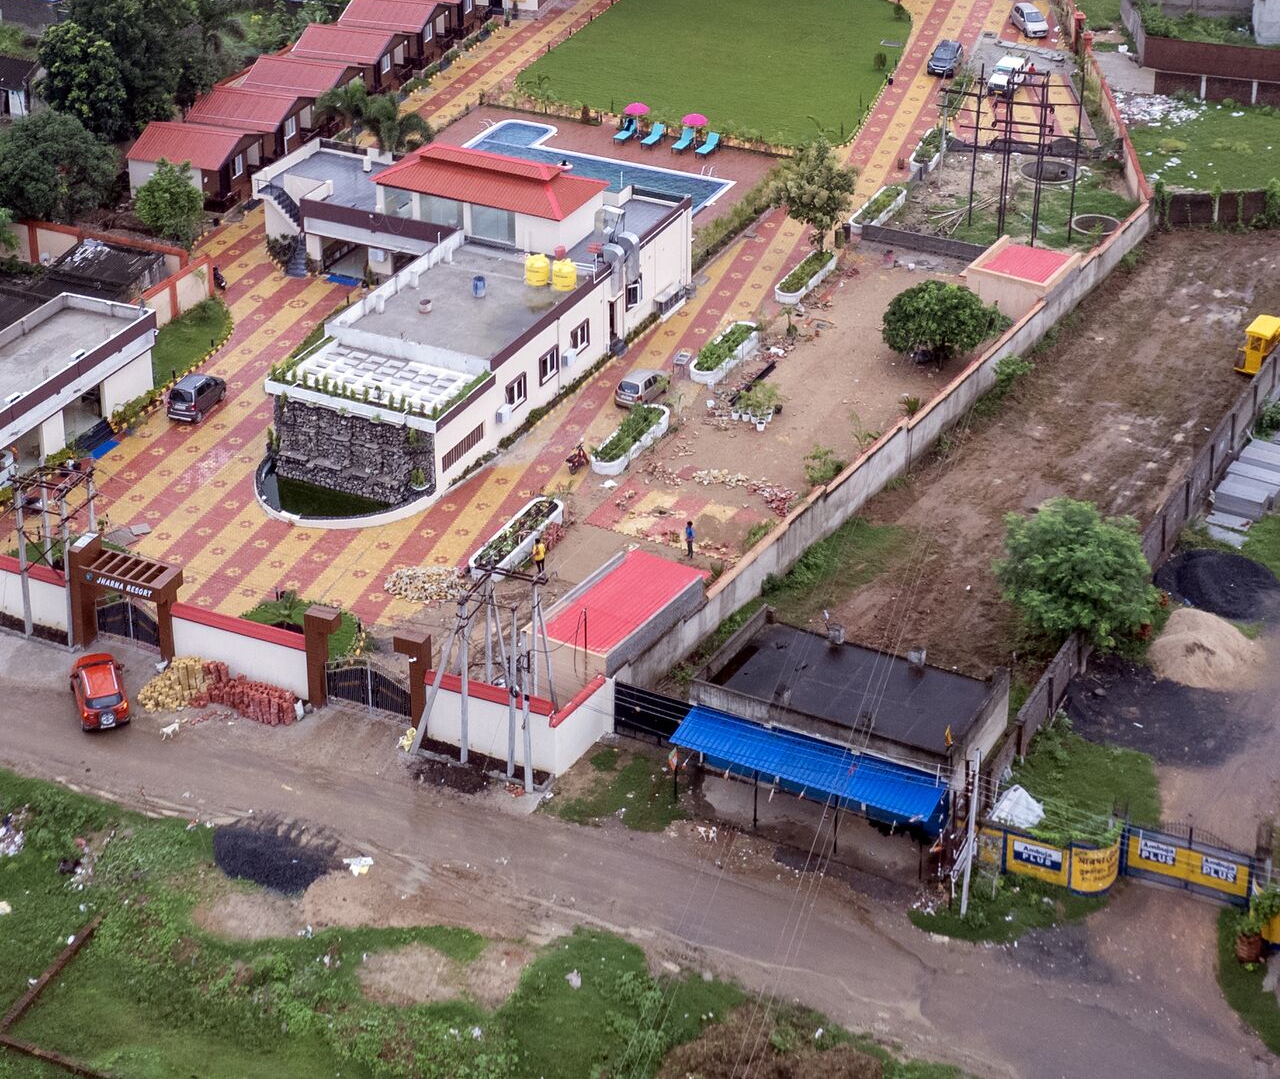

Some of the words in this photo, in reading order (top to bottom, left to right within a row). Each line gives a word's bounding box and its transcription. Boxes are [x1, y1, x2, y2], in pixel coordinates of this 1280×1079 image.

[96, 576, 124, 591] JHARNA
[125, 584, 153, 598] RESORT
[1023, 845, 1053, 859] Ambuja
[1141, 850, 1175, 866] PLUS
[1202, 865, 1236, 883] PLUS
